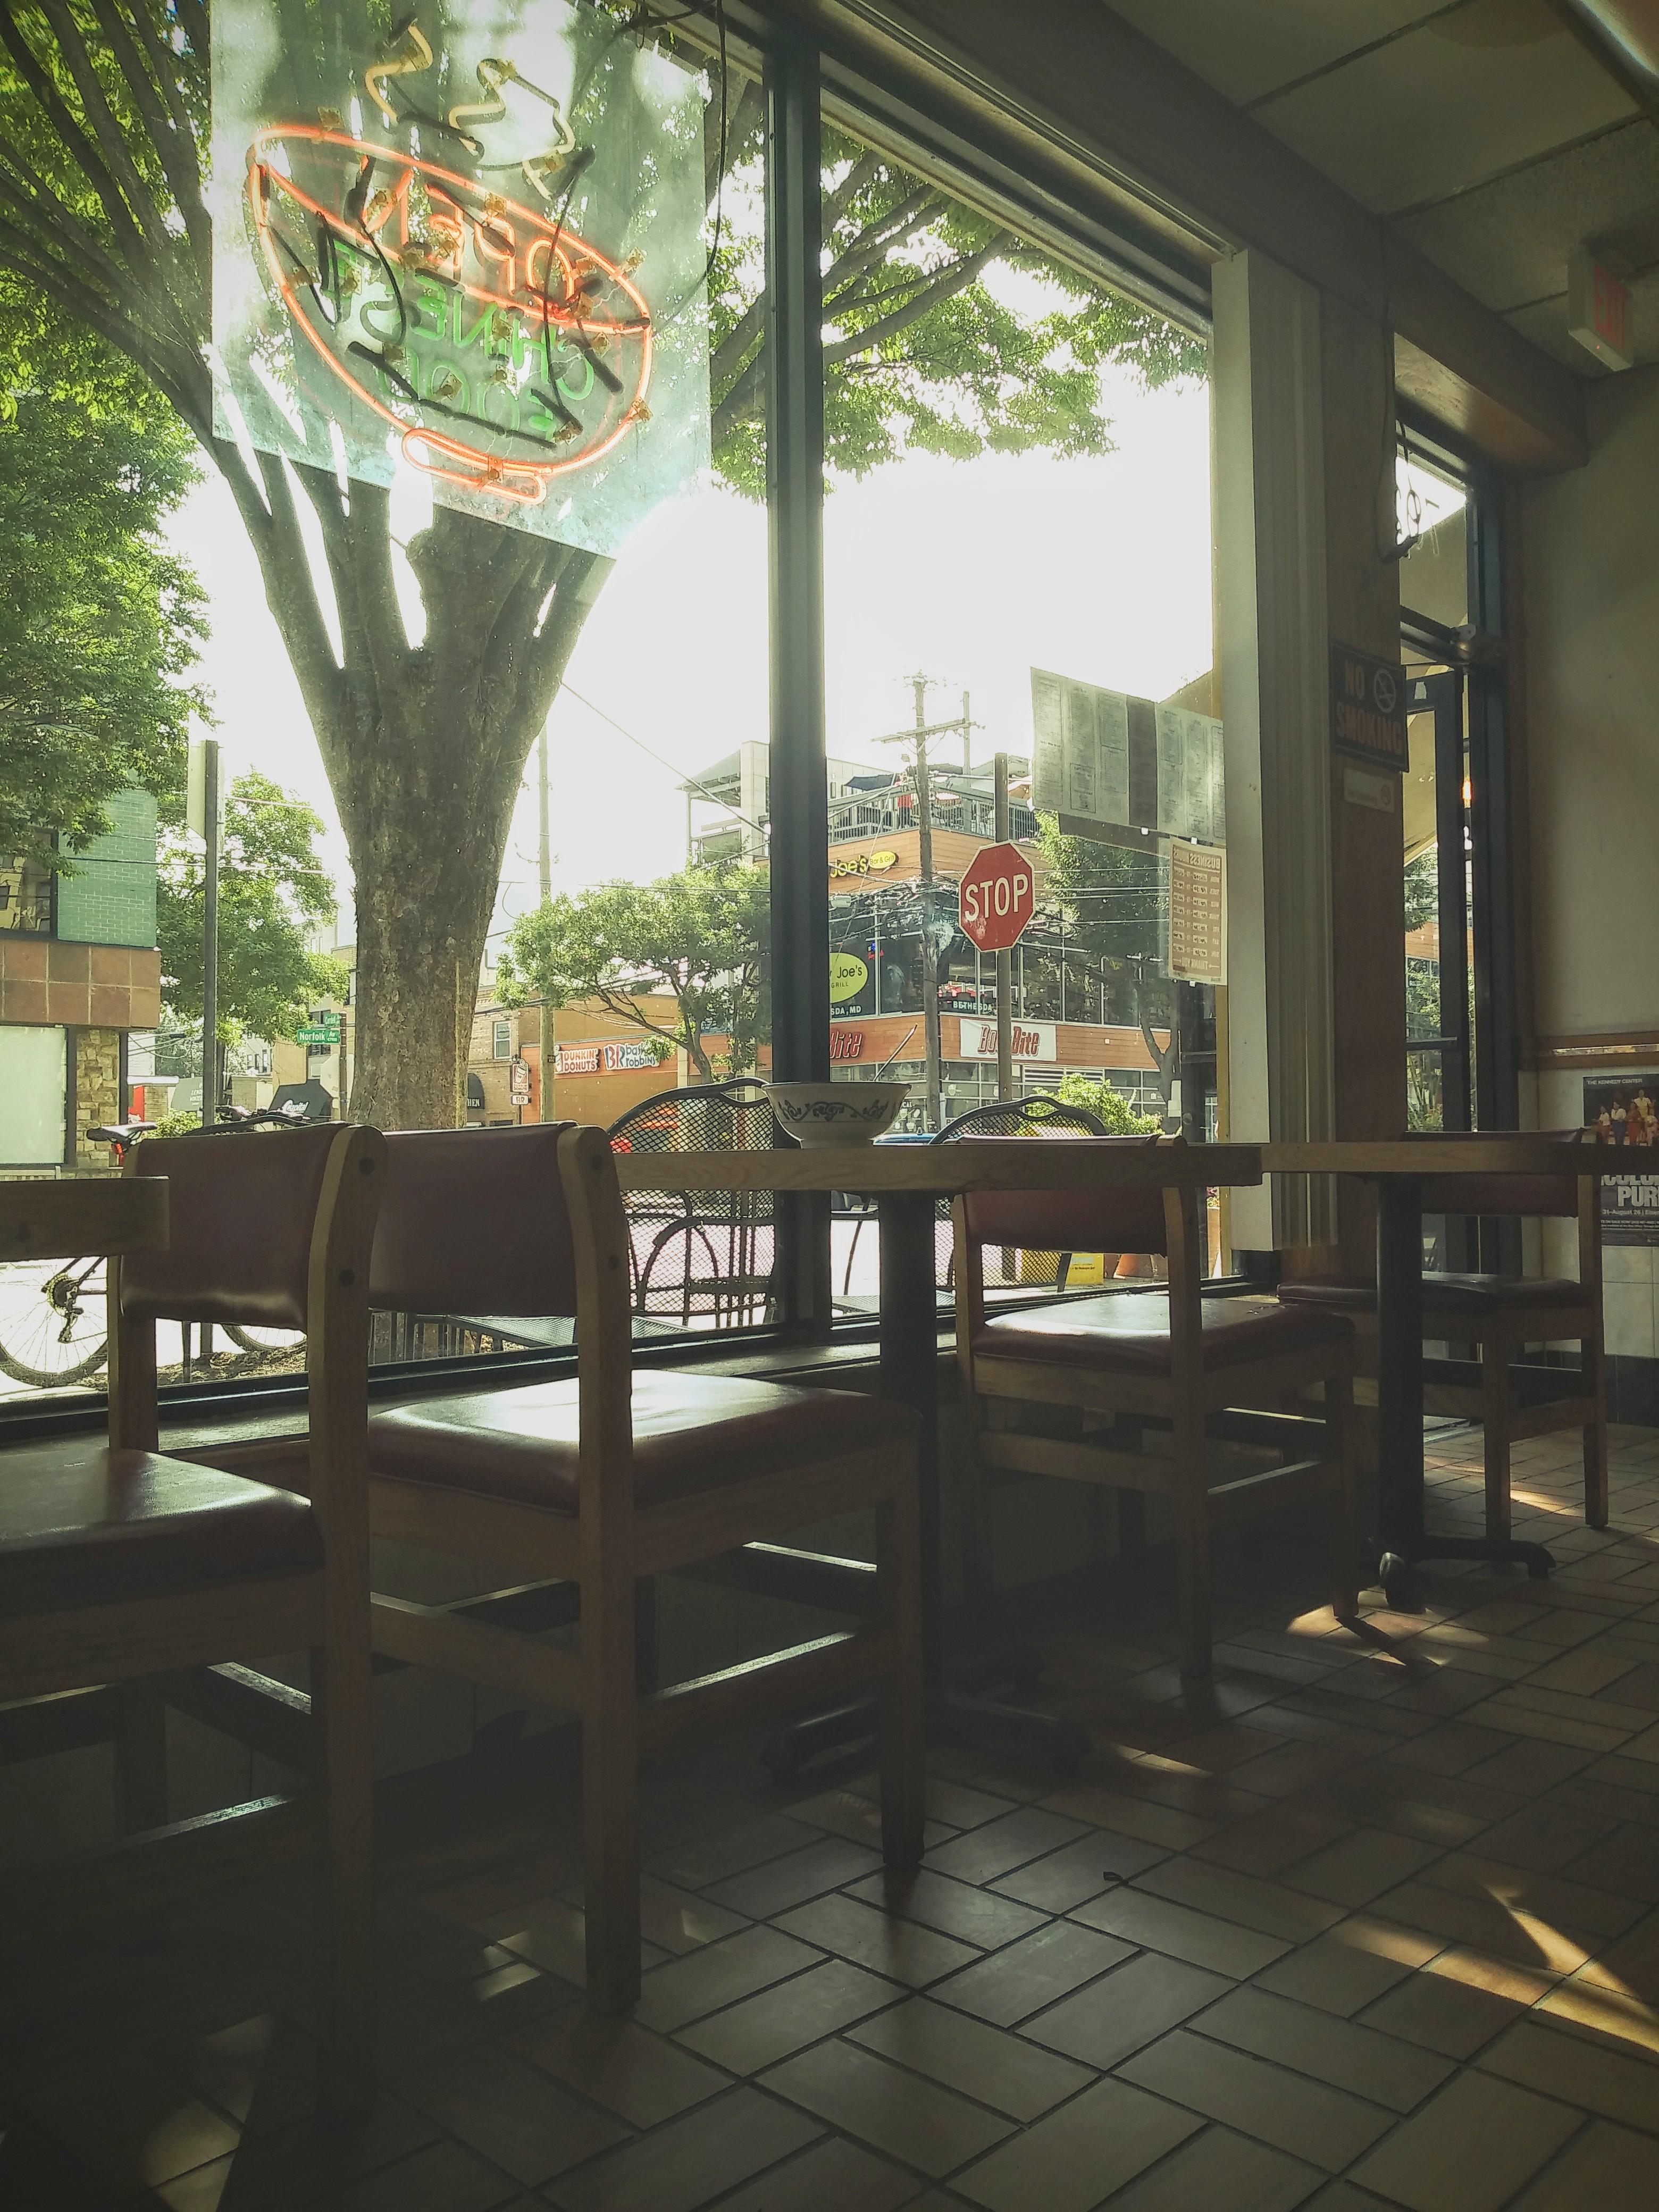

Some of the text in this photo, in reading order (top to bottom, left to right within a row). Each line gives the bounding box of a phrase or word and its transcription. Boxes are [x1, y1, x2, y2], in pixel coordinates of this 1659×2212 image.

[1344, 660, 1365, 700] NO
[1337, 701, 1403, 755] SMOKING
[830, 855, 867, 878] Joe's
[965, 874, 1029, 921] STOP
[837, 965, 862, 979] Joe's
[953, 1000, 992, 1011] BETHESDA
[299, 1030, 325, 1041] Norfolk
[565, 1060, 596, 1071] DONUTS
[1618, 1186, 1659, 1206] PUR
